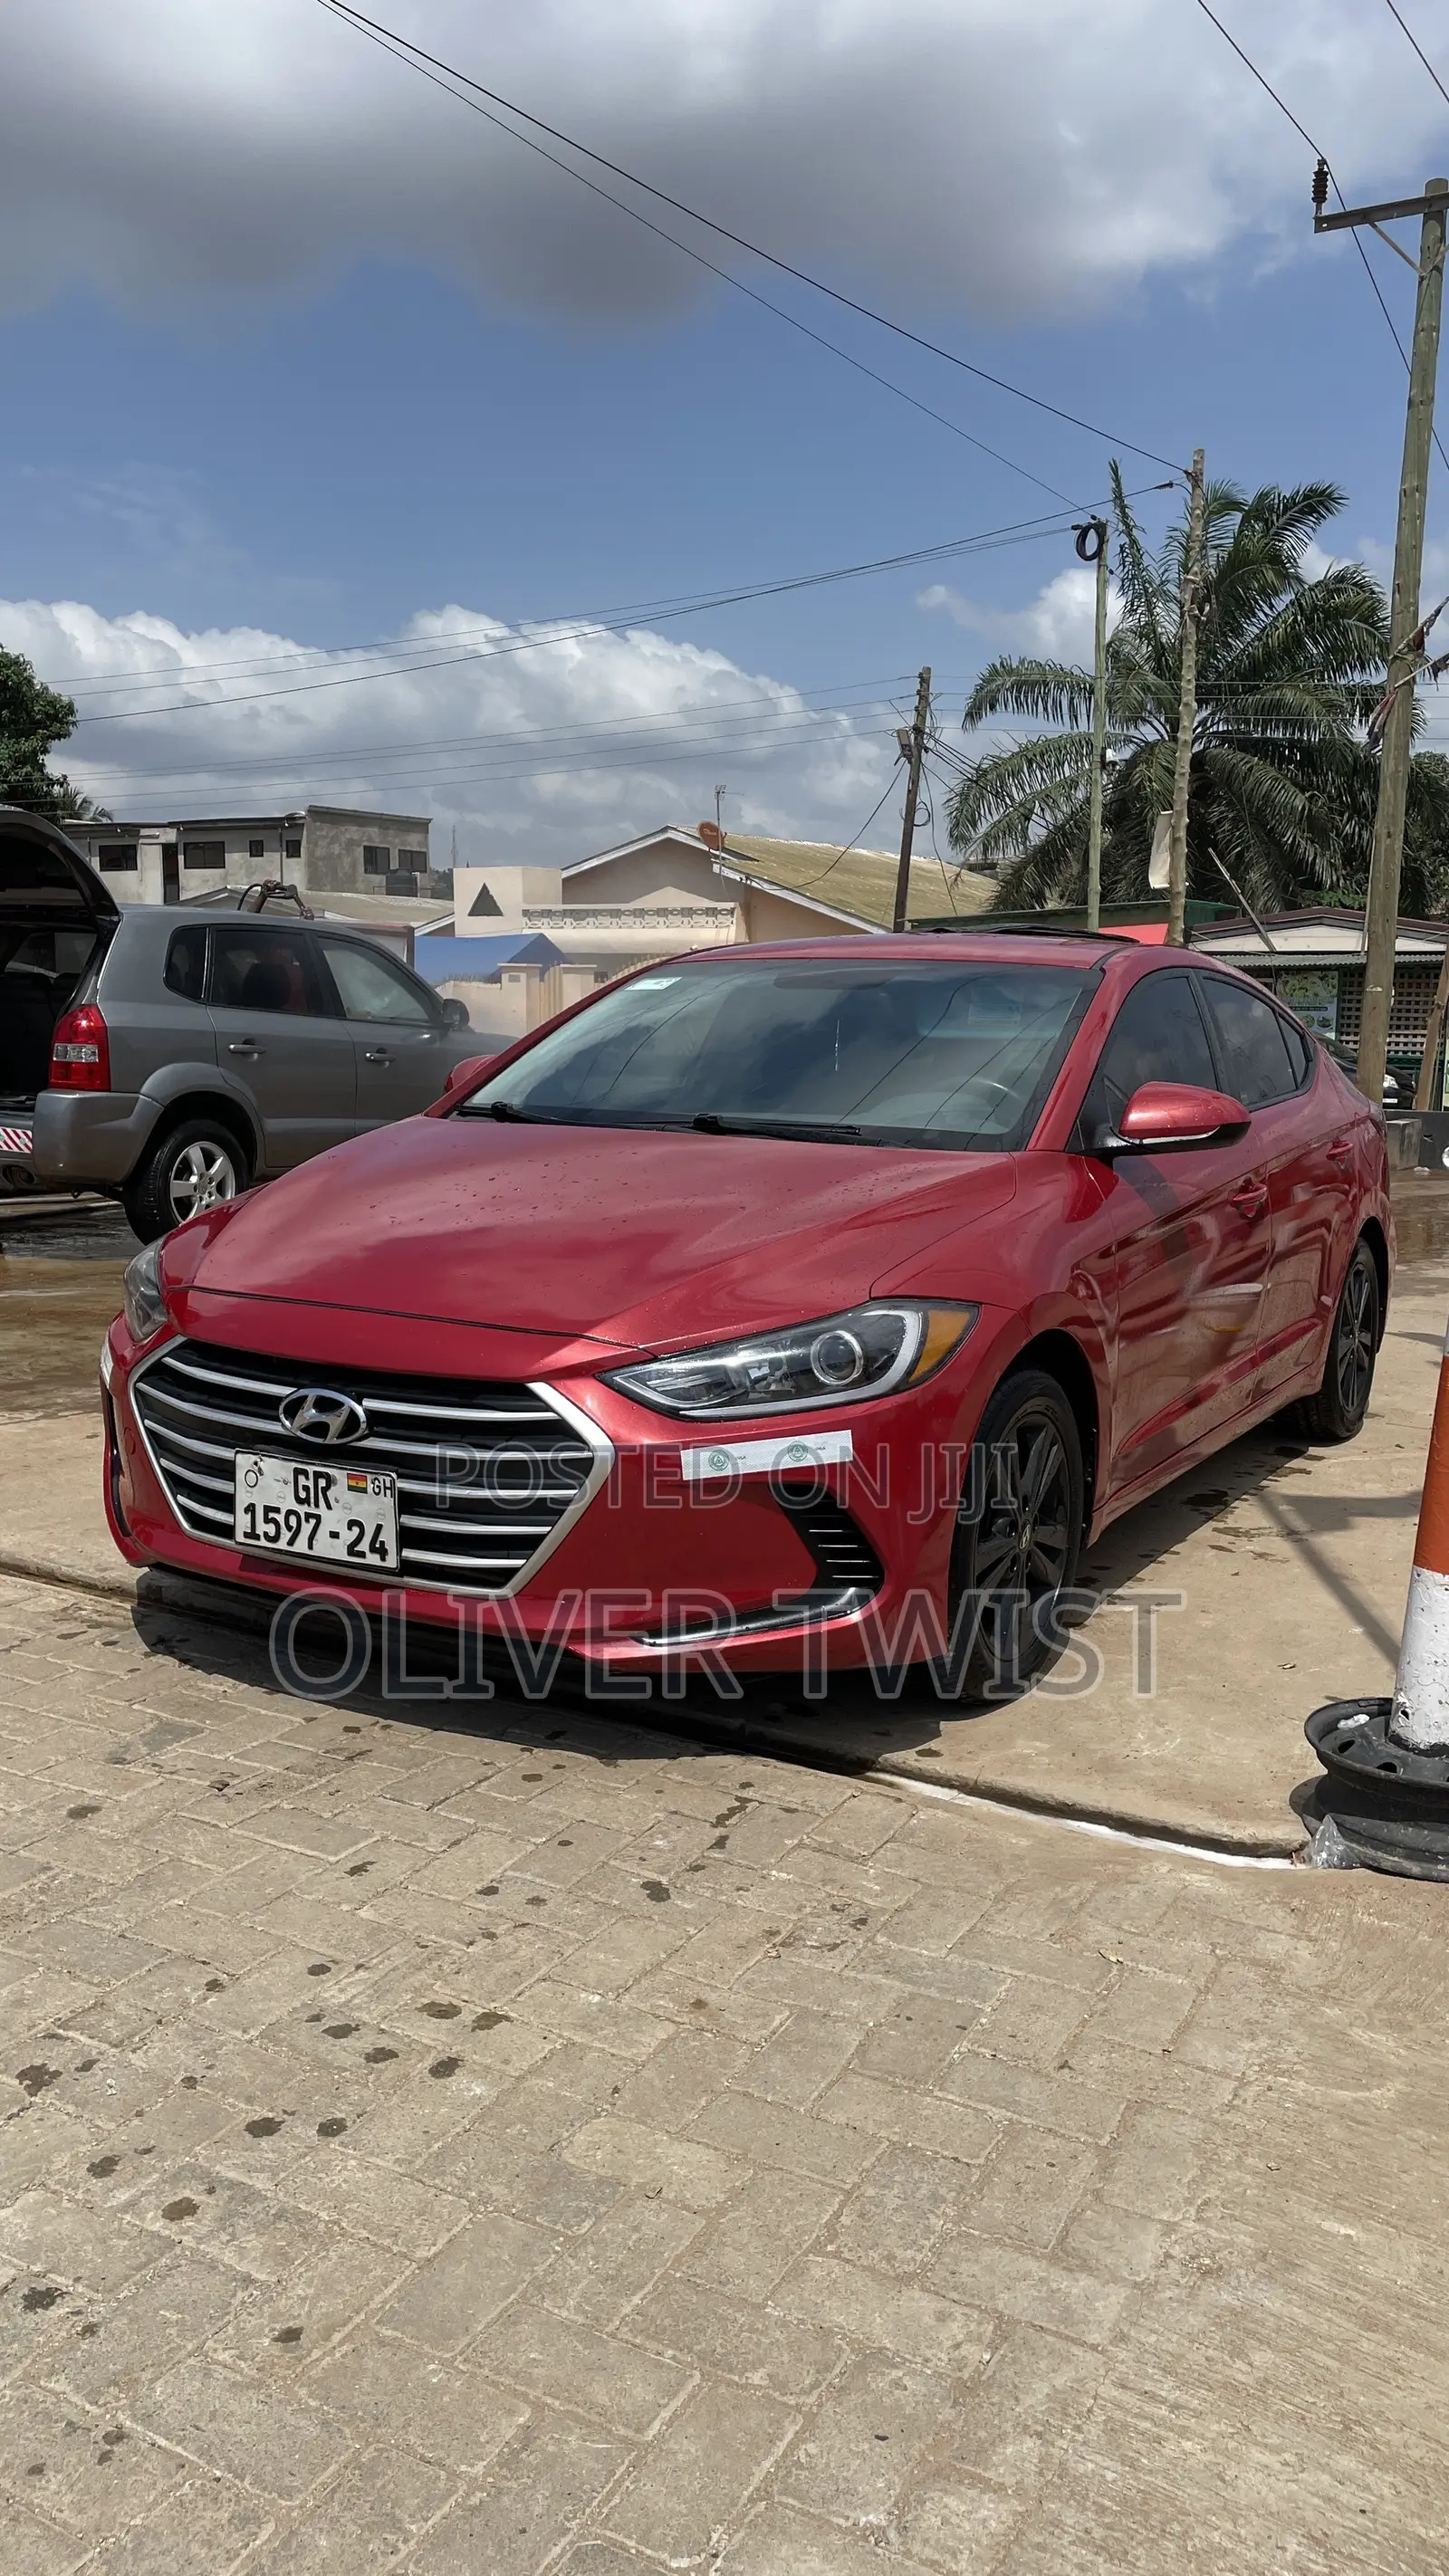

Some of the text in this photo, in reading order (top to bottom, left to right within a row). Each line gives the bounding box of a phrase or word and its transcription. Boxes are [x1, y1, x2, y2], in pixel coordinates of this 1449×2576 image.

[293, 1466, 332, 1510] GR
[371, 1477, 393, 1499] GH
[243, 1502, 389, 1562] 1597-24
